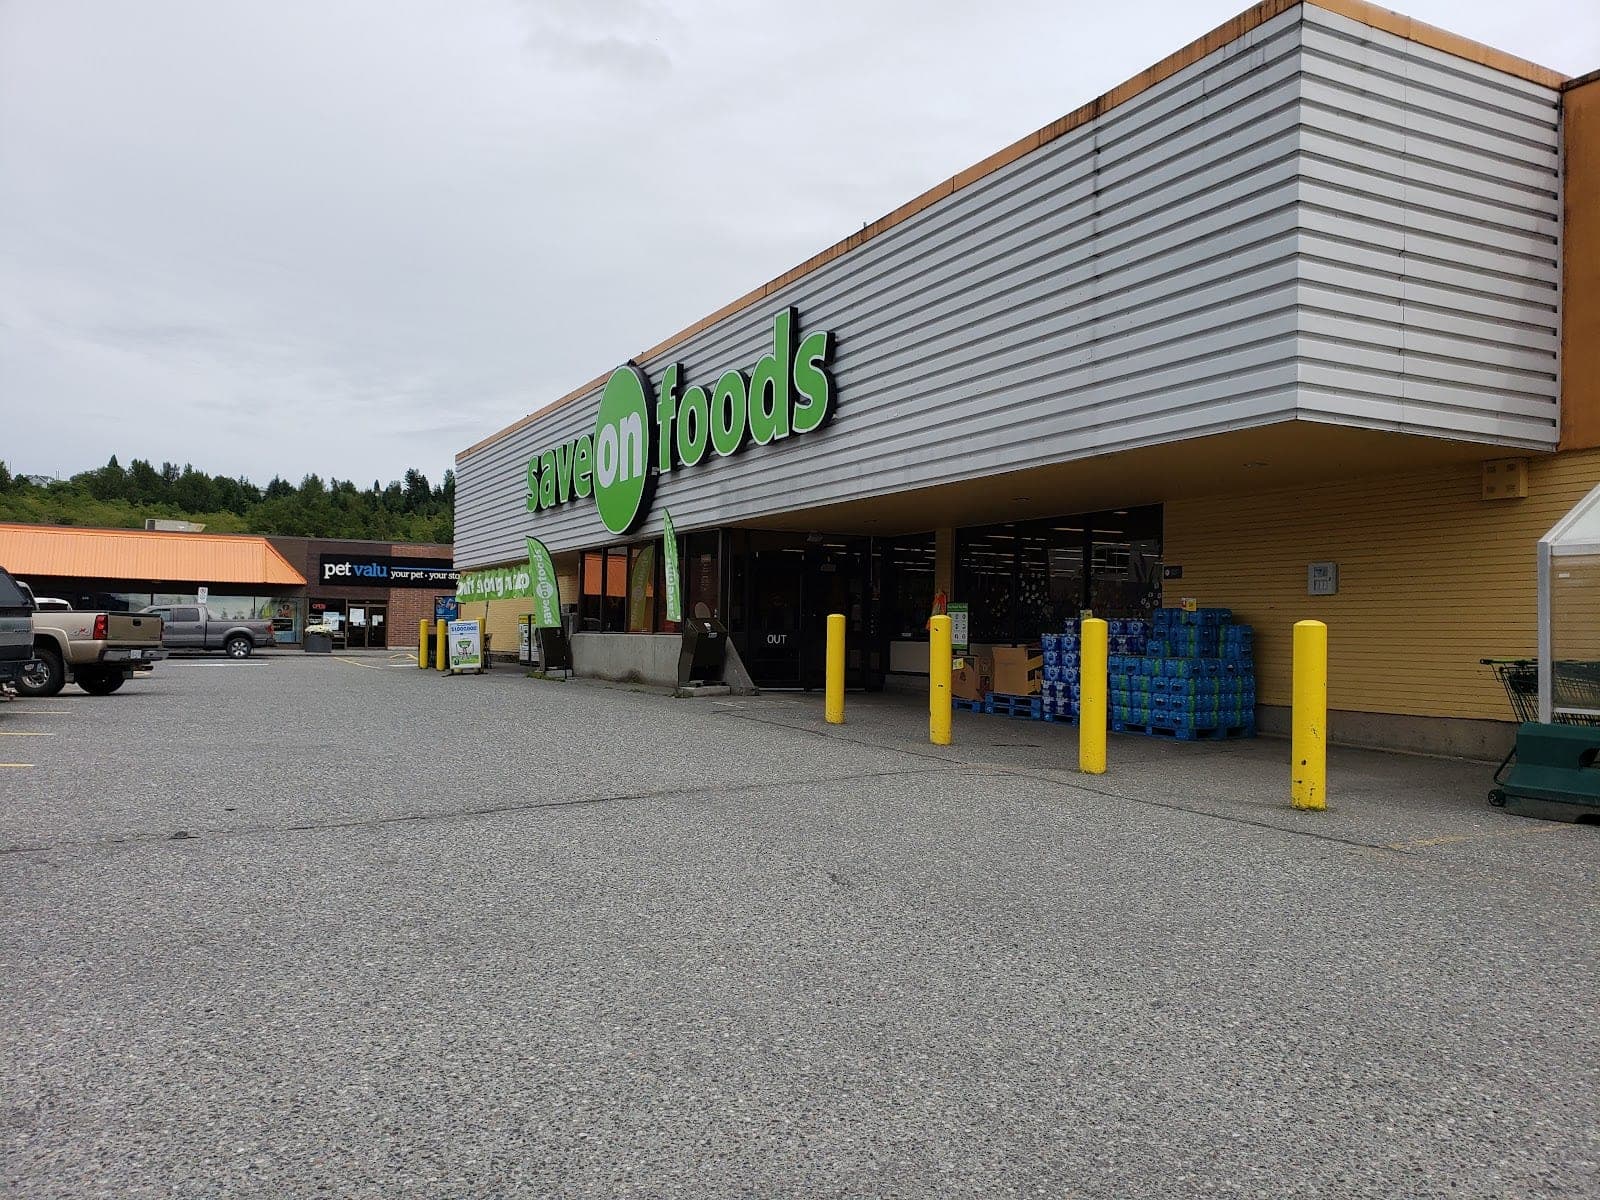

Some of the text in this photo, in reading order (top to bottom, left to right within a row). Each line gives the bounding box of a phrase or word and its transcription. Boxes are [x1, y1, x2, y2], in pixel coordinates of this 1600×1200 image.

[525, 307, 834, 514] save on foods
[323, 561, 461, 580] pet valu your pet your sto
[767, 634, 787, 644] OUT
